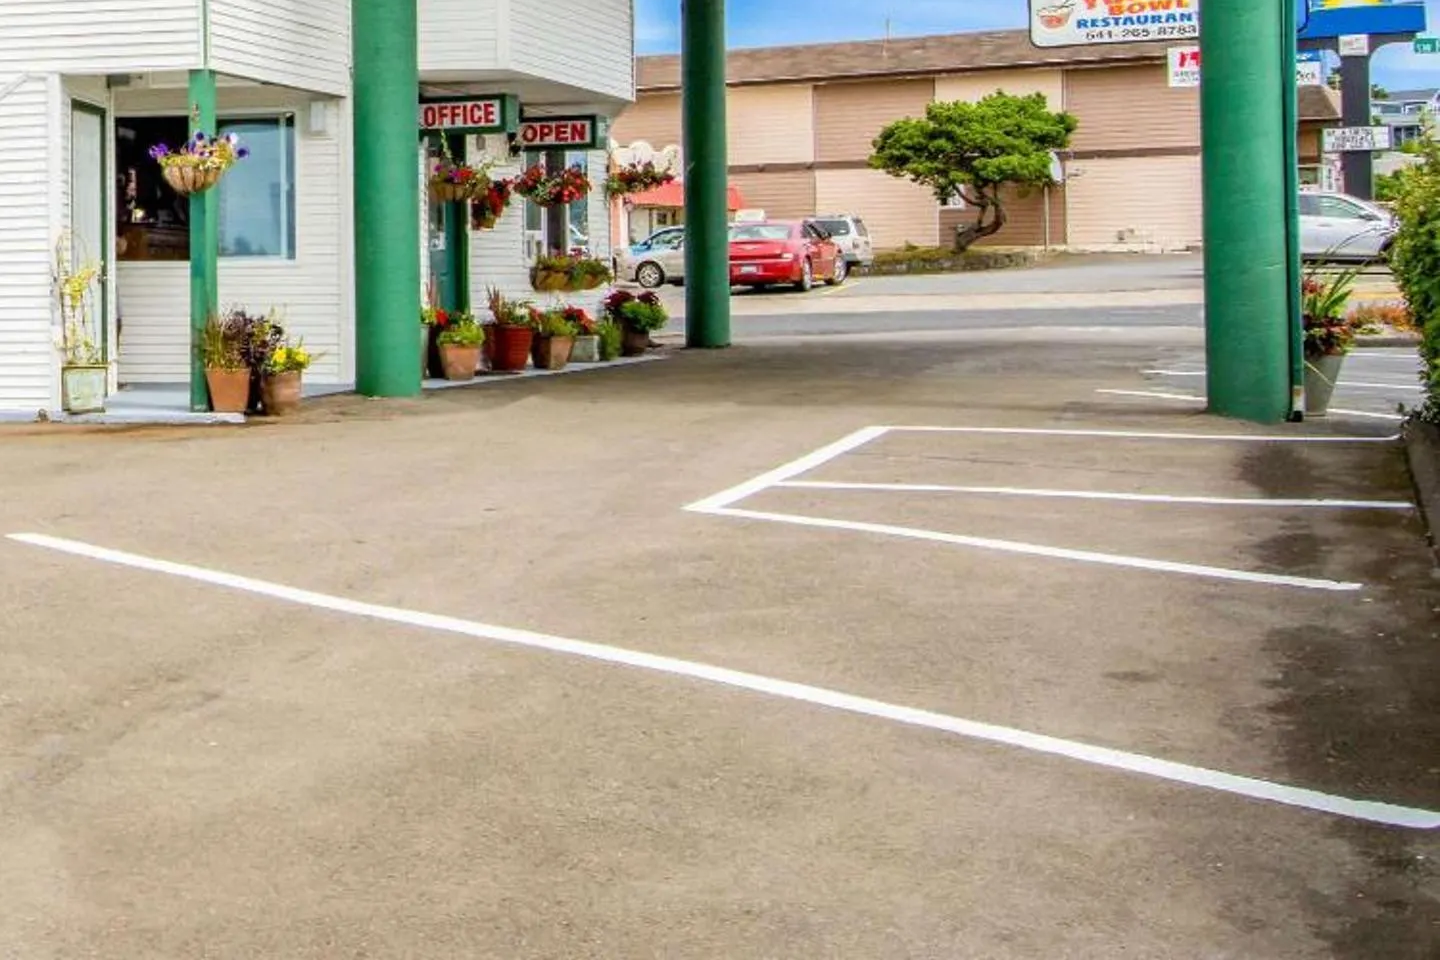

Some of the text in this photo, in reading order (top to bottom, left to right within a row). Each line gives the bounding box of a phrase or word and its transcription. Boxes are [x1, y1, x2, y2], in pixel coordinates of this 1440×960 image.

[1076, 12, 1198, 29] RESTAURAN
[424, 103, 495, 127] OFFICE
[522, 123, 586, 143] OPEN
